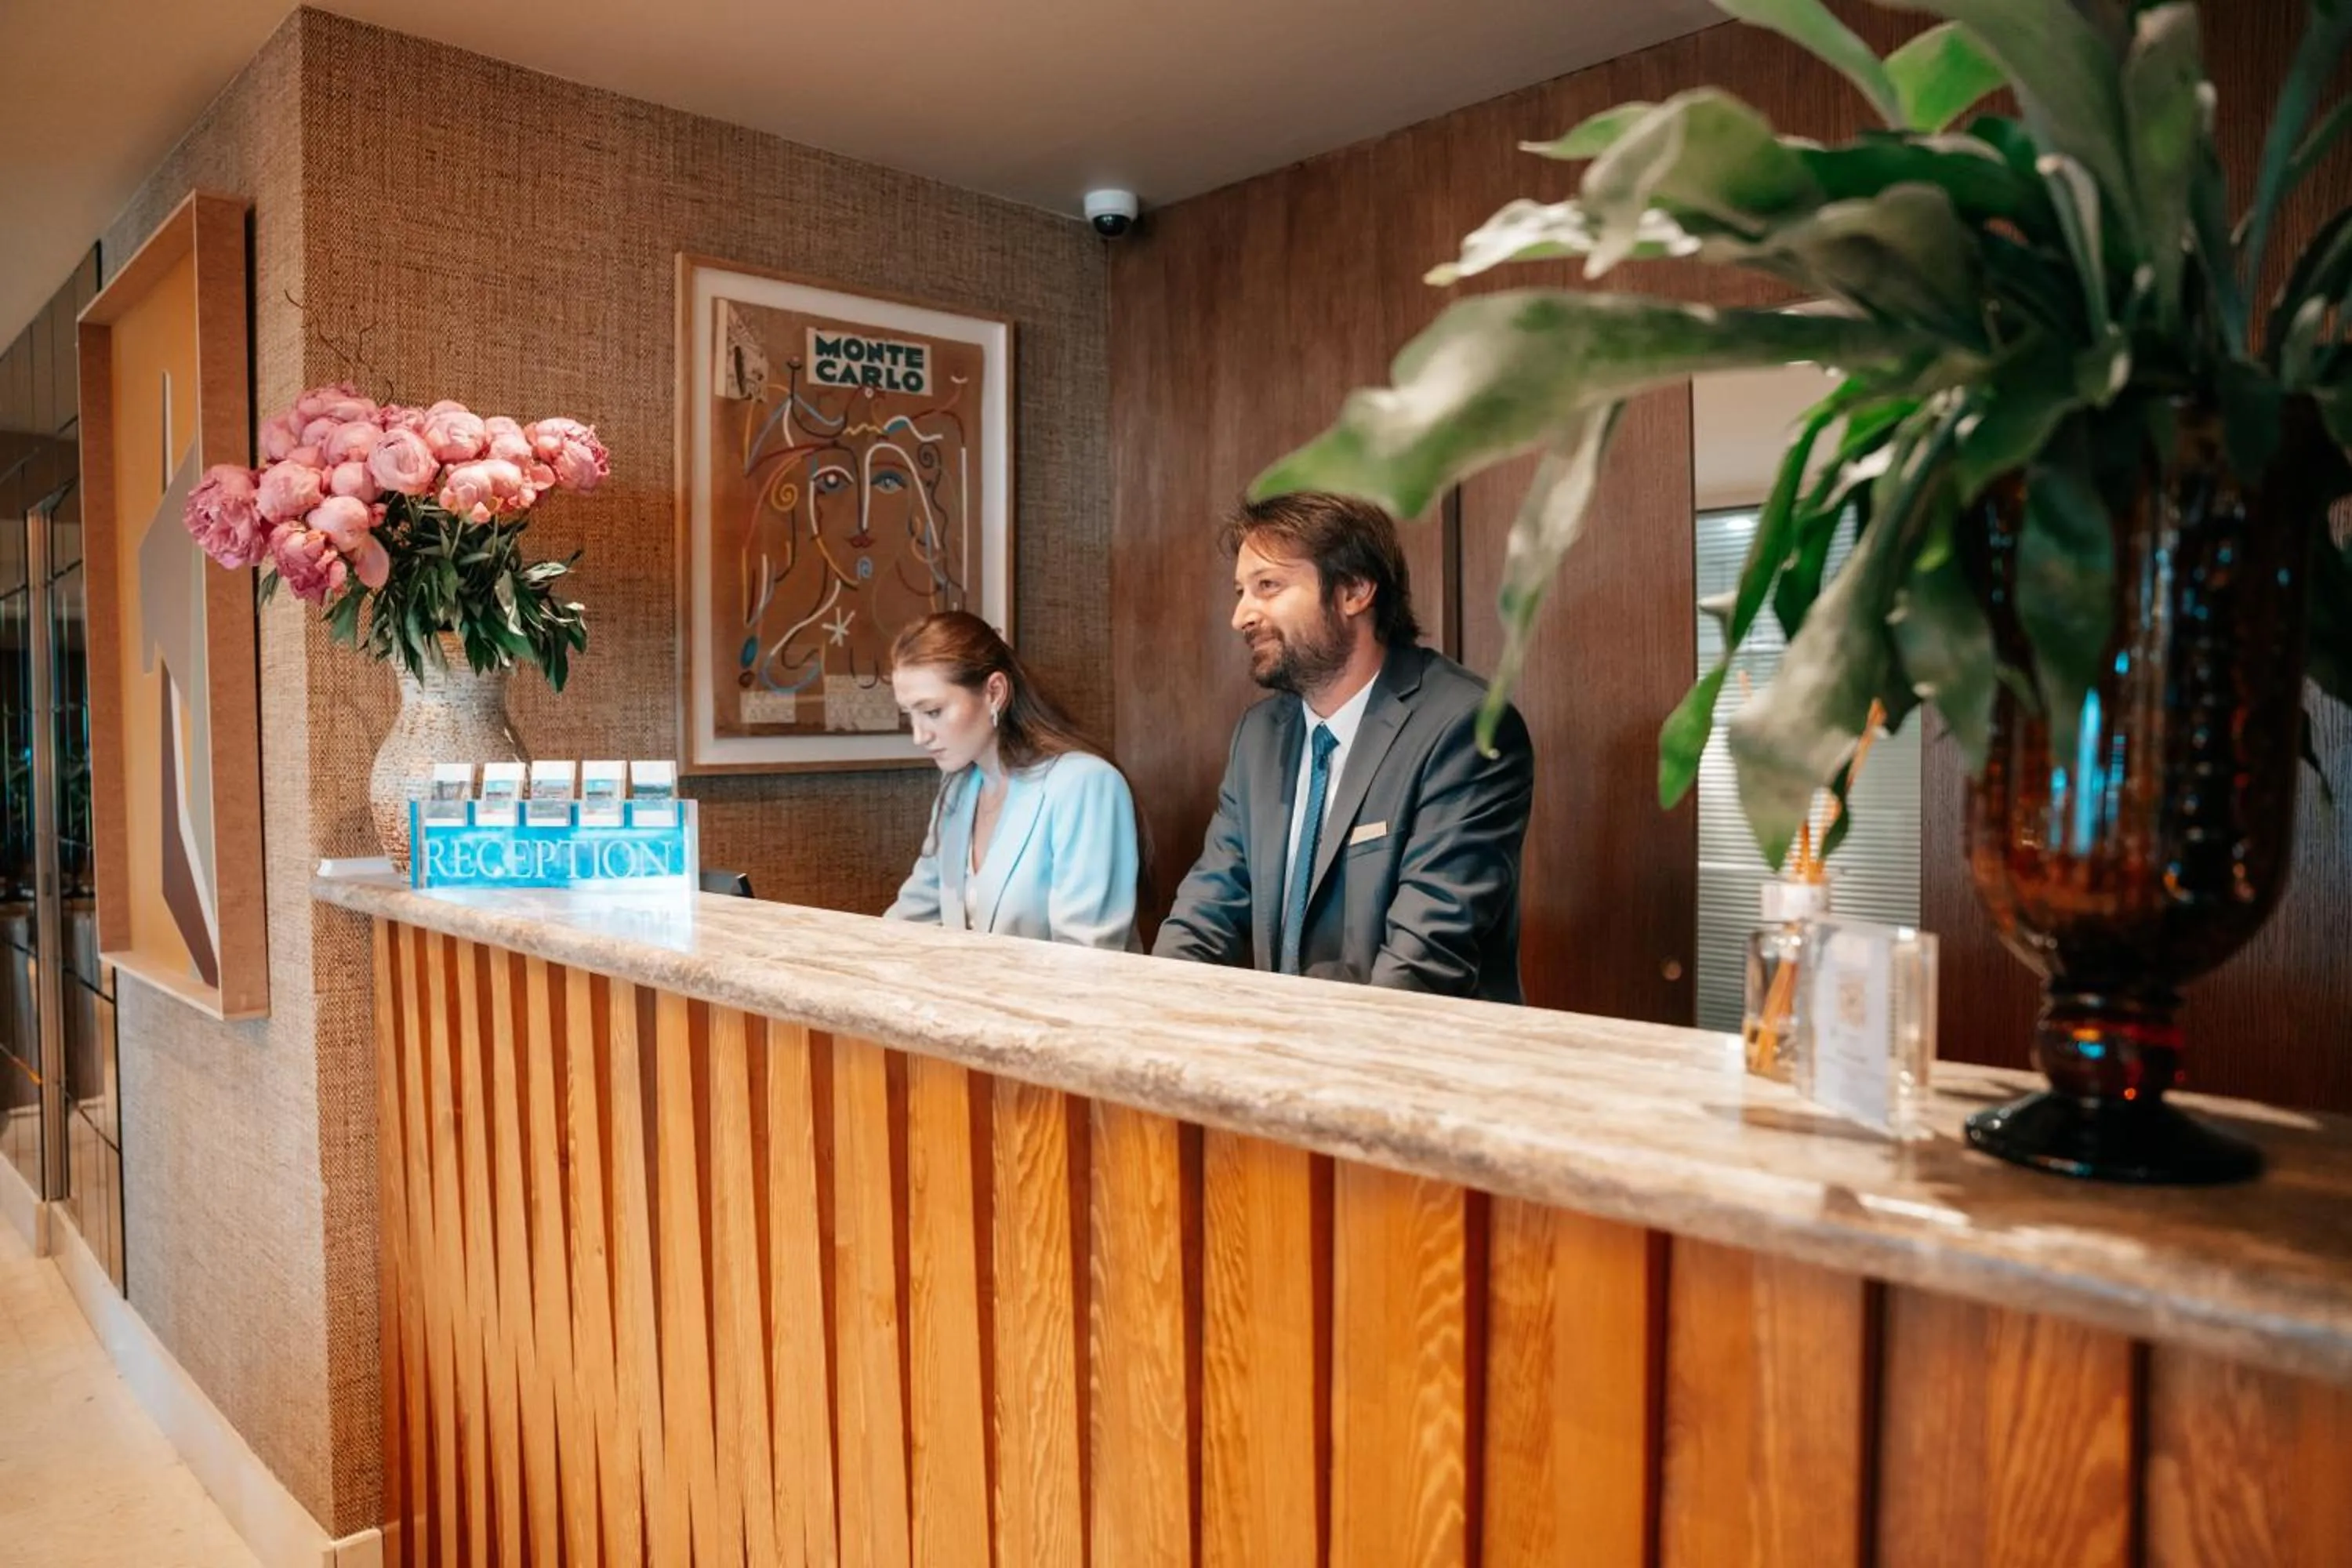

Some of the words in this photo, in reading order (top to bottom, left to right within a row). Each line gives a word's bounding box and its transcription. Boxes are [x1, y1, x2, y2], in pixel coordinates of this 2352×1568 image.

[815, 335, 924, 369] MONTE
[815, 359, 924, 392] CARLO
[425, 839, 672, 879] RECEPTION
